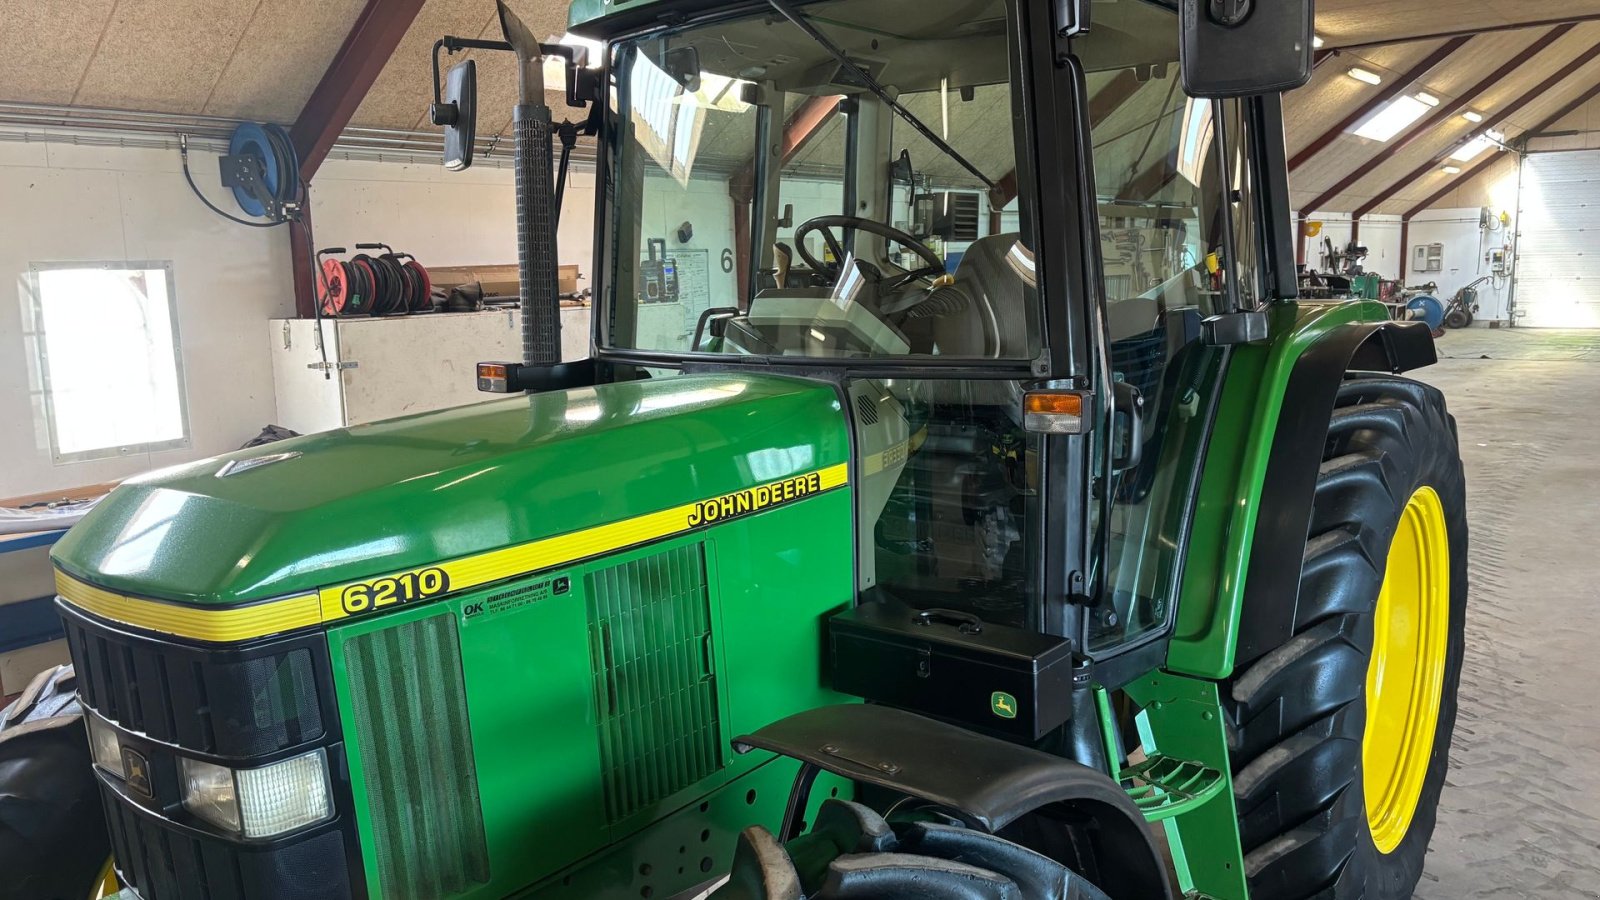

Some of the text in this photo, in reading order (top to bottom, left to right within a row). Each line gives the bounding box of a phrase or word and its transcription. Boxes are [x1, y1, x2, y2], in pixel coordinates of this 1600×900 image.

[721, 249, 733, 273] 6
[688, 473, 820, 527] JOHN DEERE
[342, 568, 450, 615] 6210
[464, 602, 483, 615] OK
